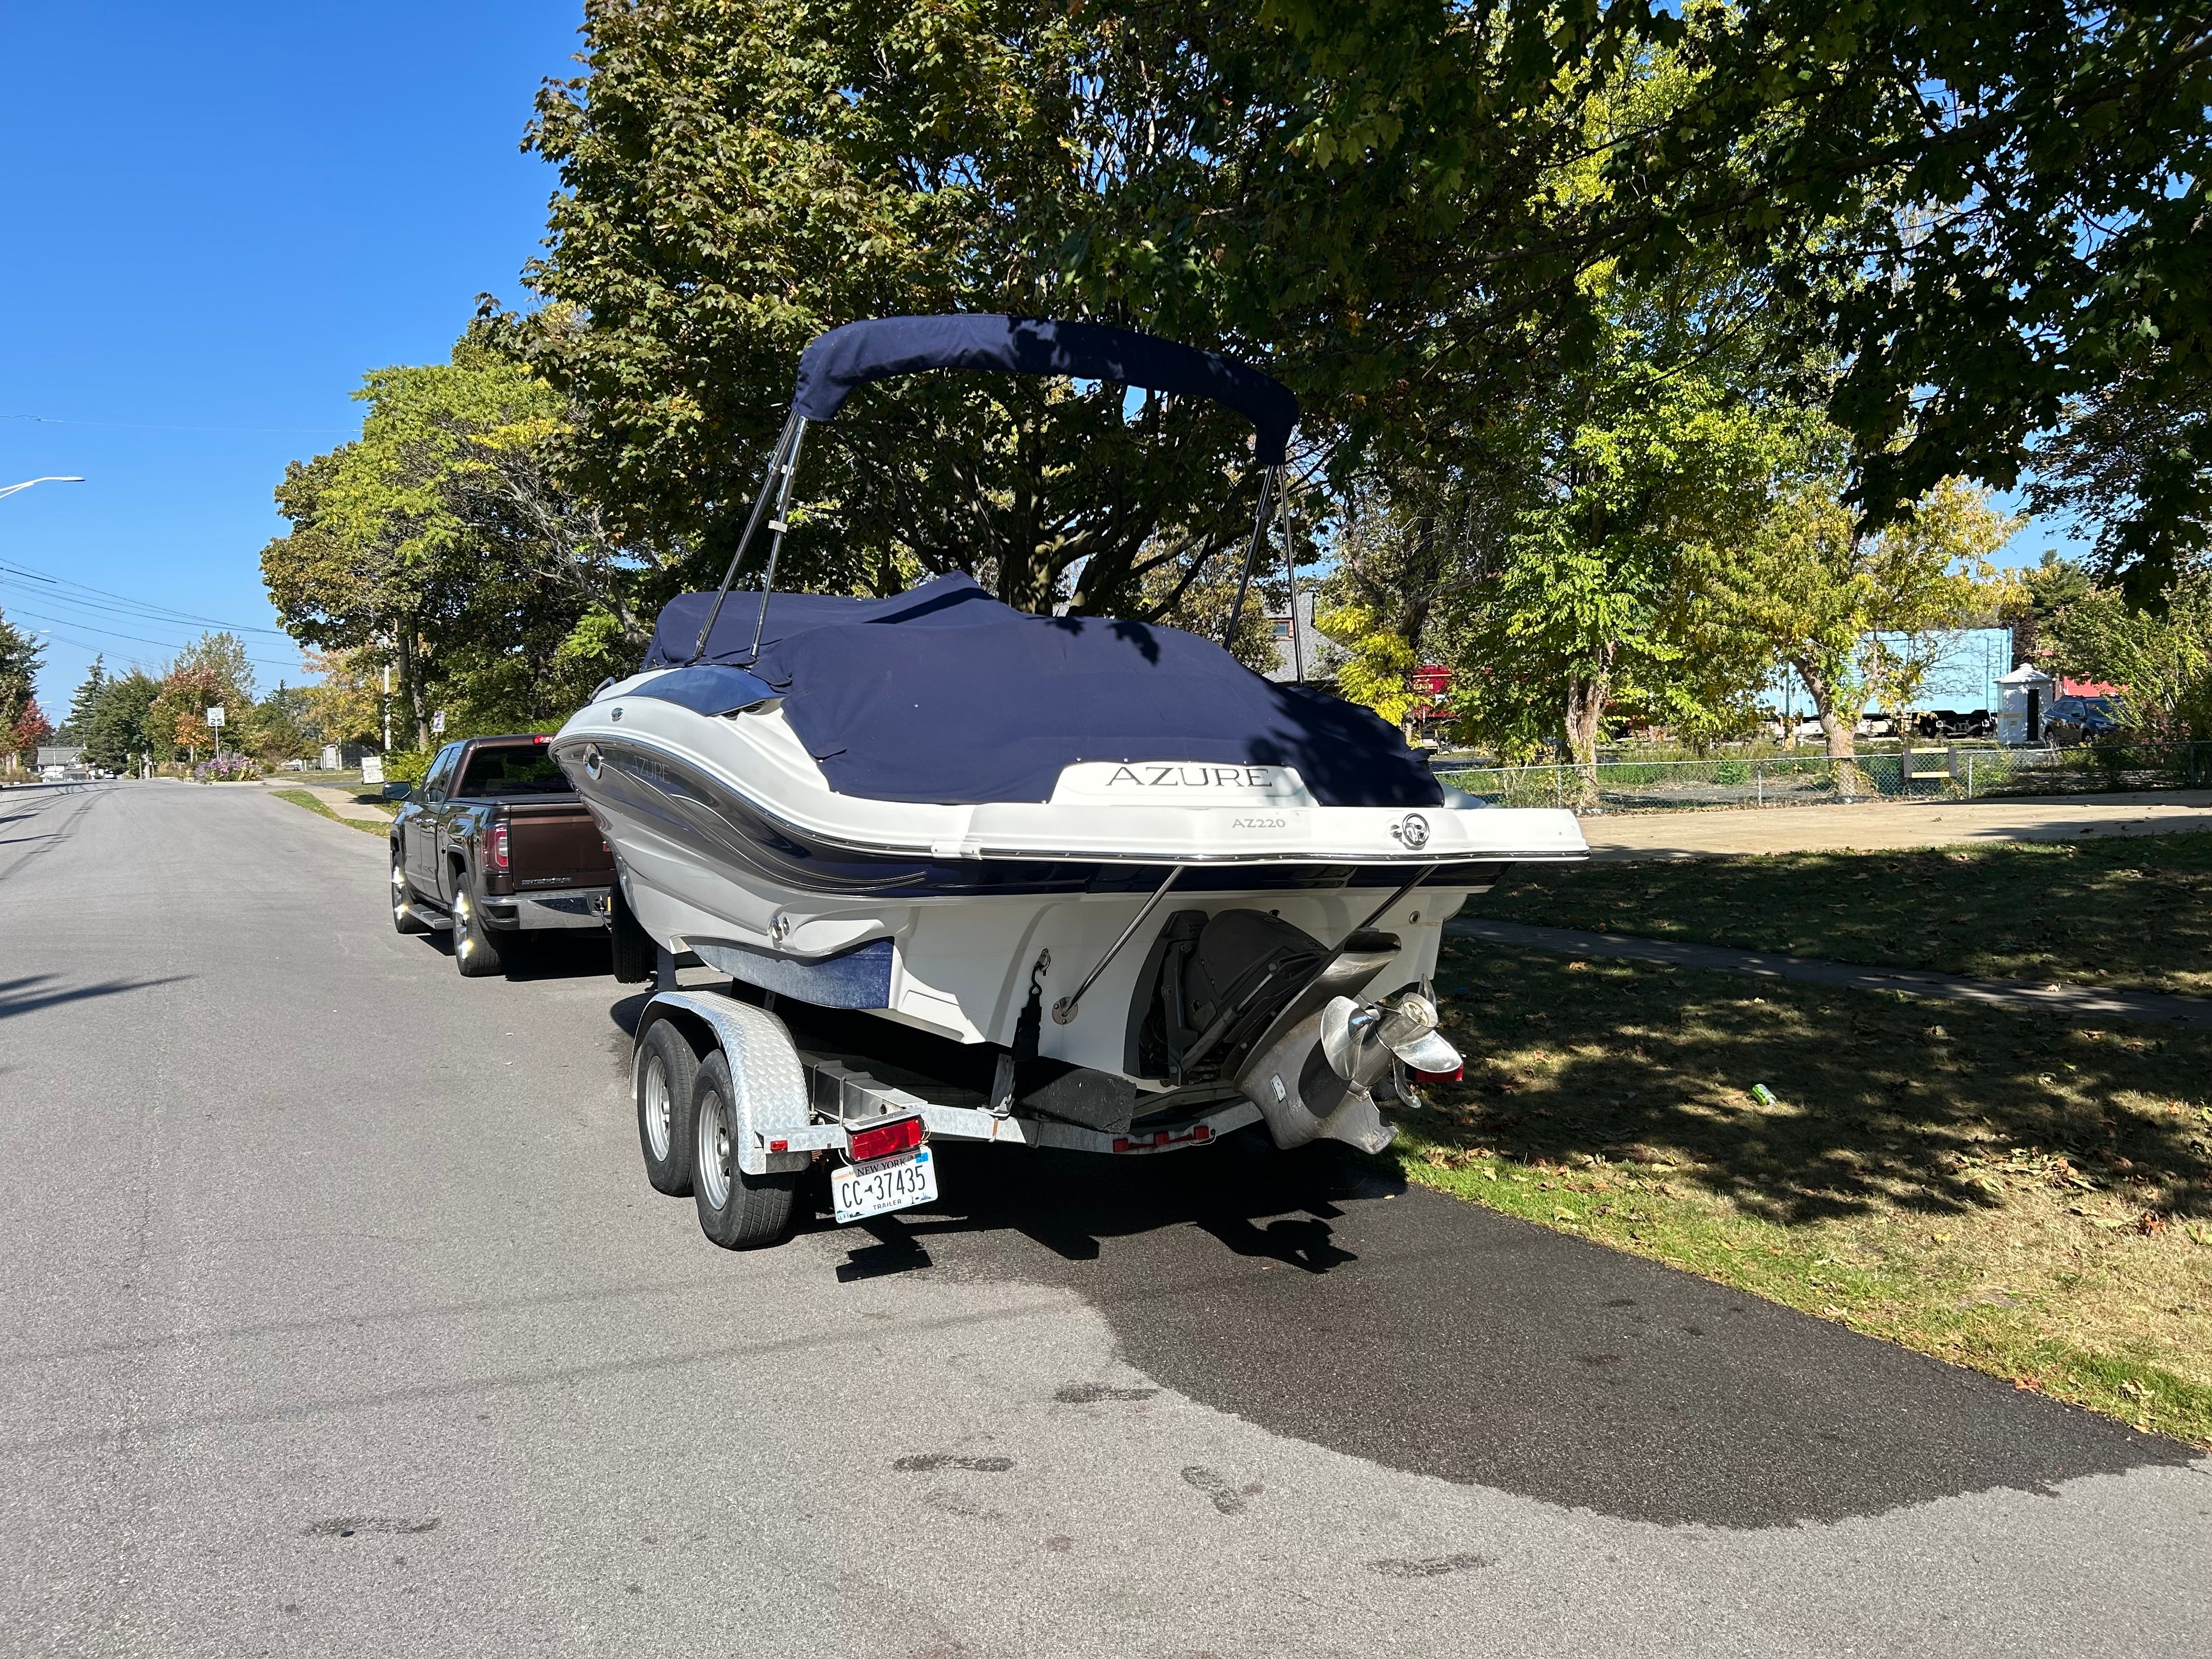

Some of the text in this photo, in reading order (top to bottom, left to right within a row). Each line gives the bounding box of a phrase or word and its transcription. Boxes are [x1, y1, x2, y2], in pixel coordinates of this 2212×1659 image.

[631, 755, 670, 784] AZURE
[1105, 767, 1272, 787] AZURE
[1232, 819, 1286, 828] AZ220
[857, 1159, 906, 1176] NEW YORK
[842, 1165, 926, 1208] CC 37435
[873, 1199, 902, 1210] TRAILER
